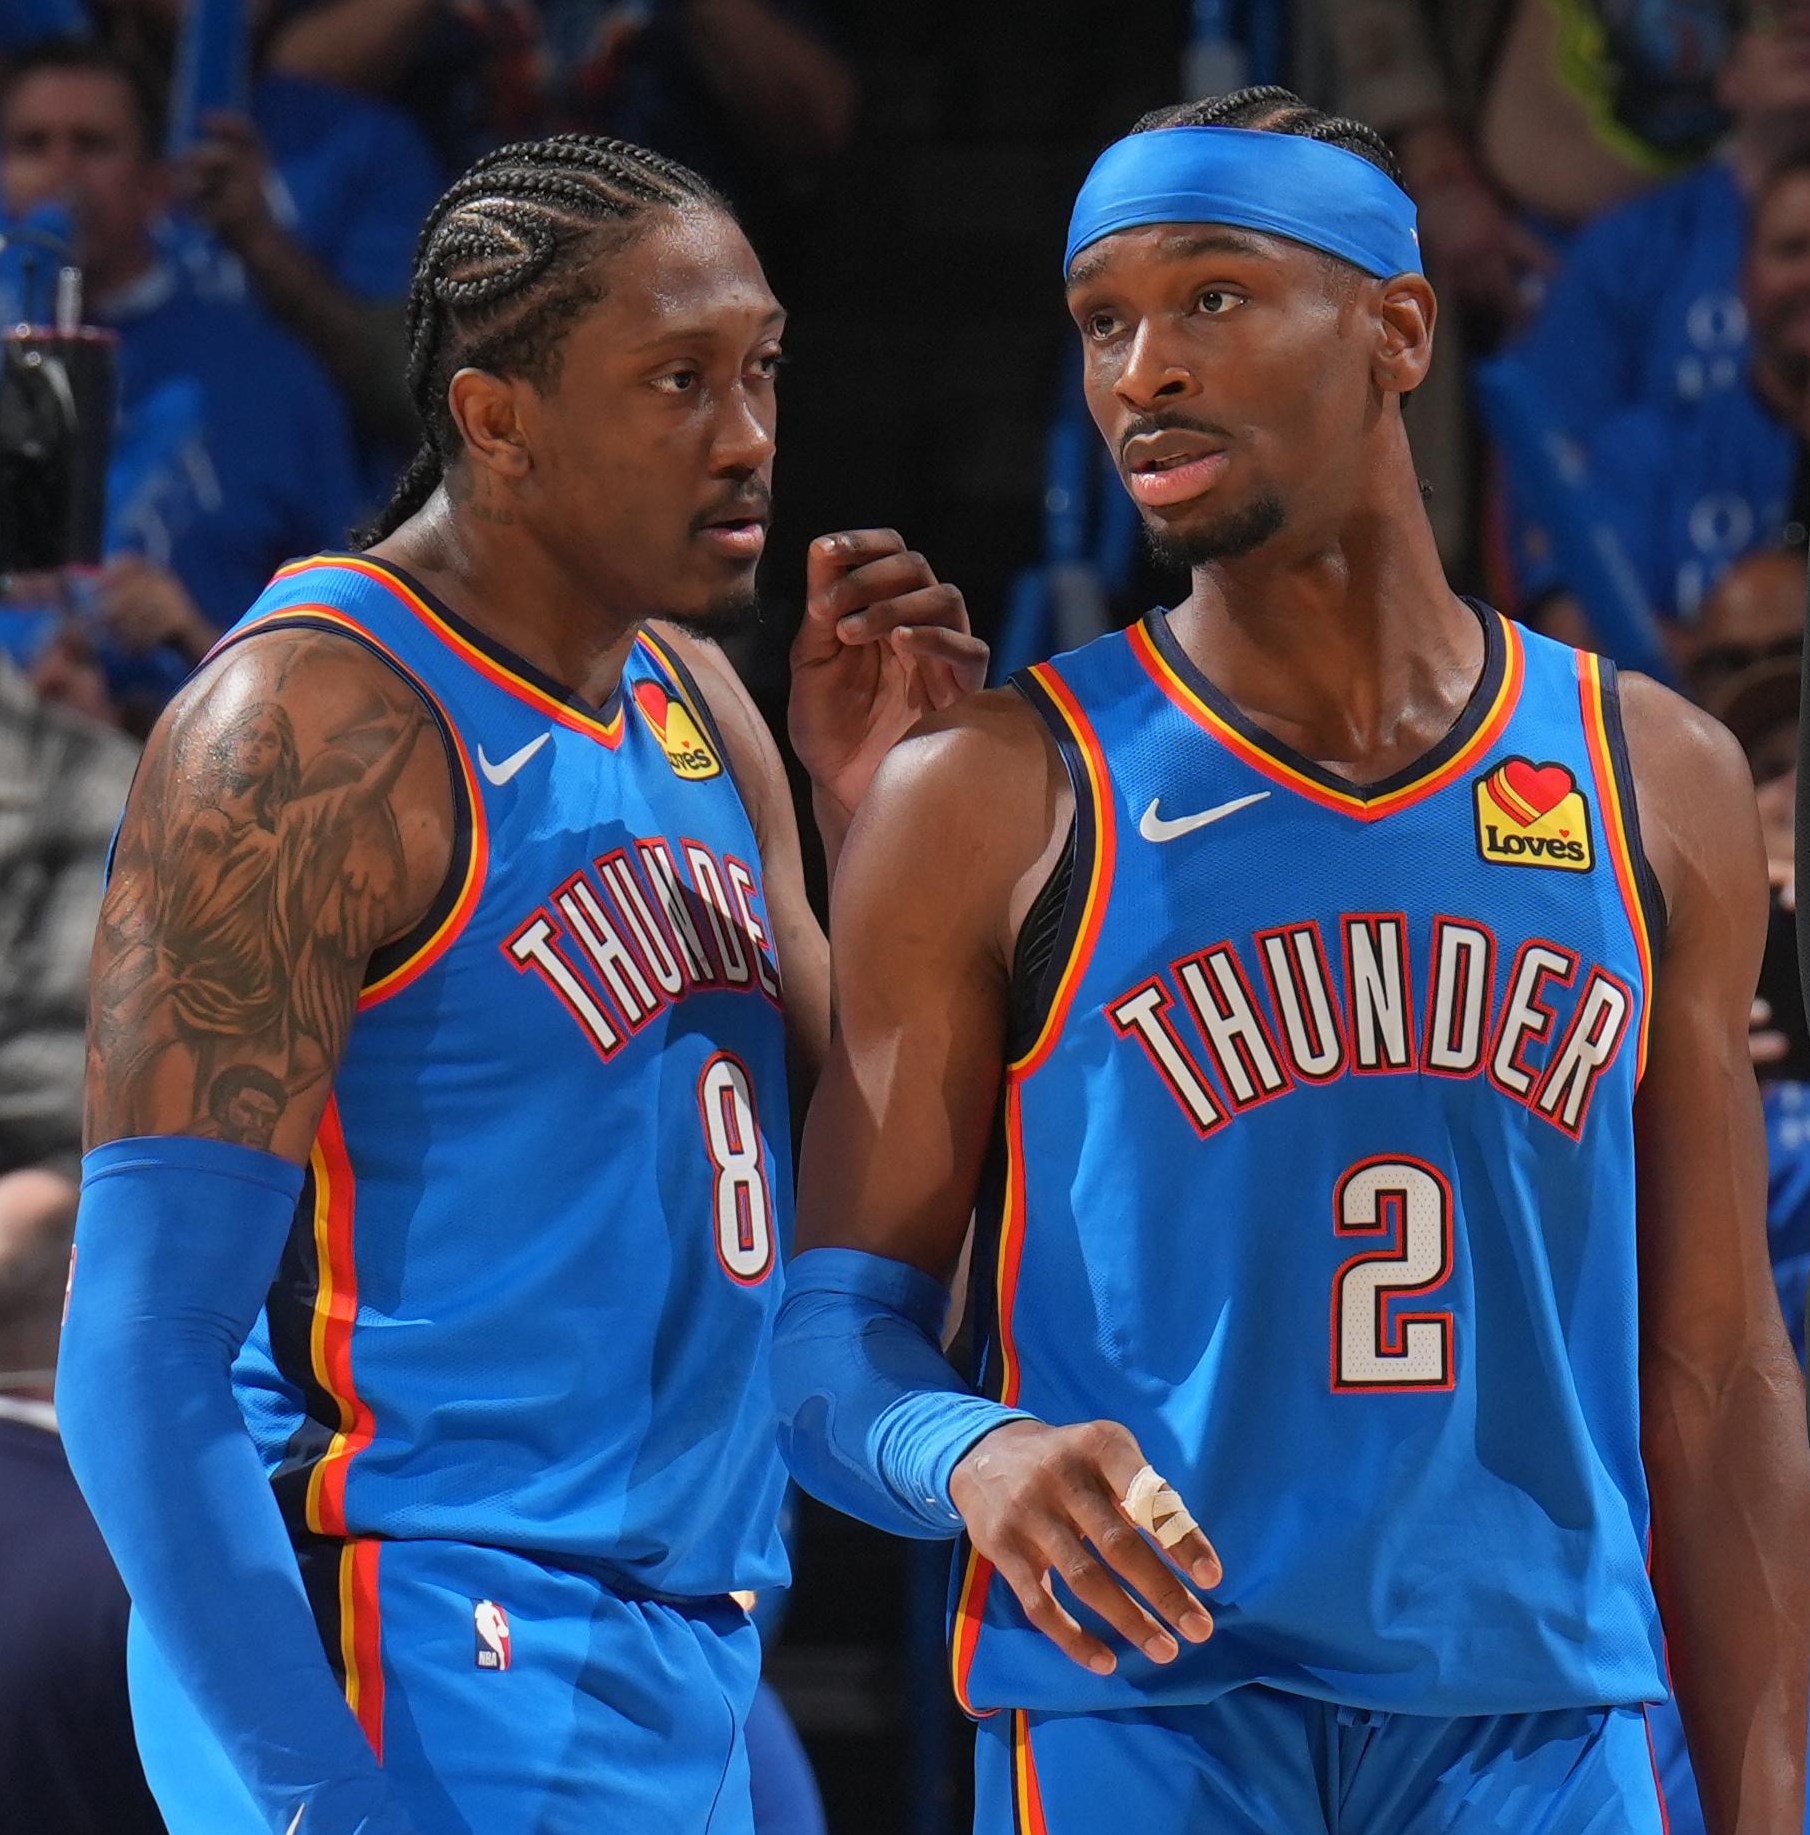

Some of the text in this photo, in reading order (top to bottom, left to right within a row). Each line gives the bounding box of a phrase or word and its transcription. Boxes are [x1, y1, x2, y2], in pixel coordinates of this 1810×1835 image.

[501, 836, 782, 1062] THUNDE
[1103, 912, 1633, 1142] THUNDER
[697, 1049, 776, 1287] 8
[1330, 1152, 1456, 1394] 2
[478, 1650, 498, 1666] NBA
